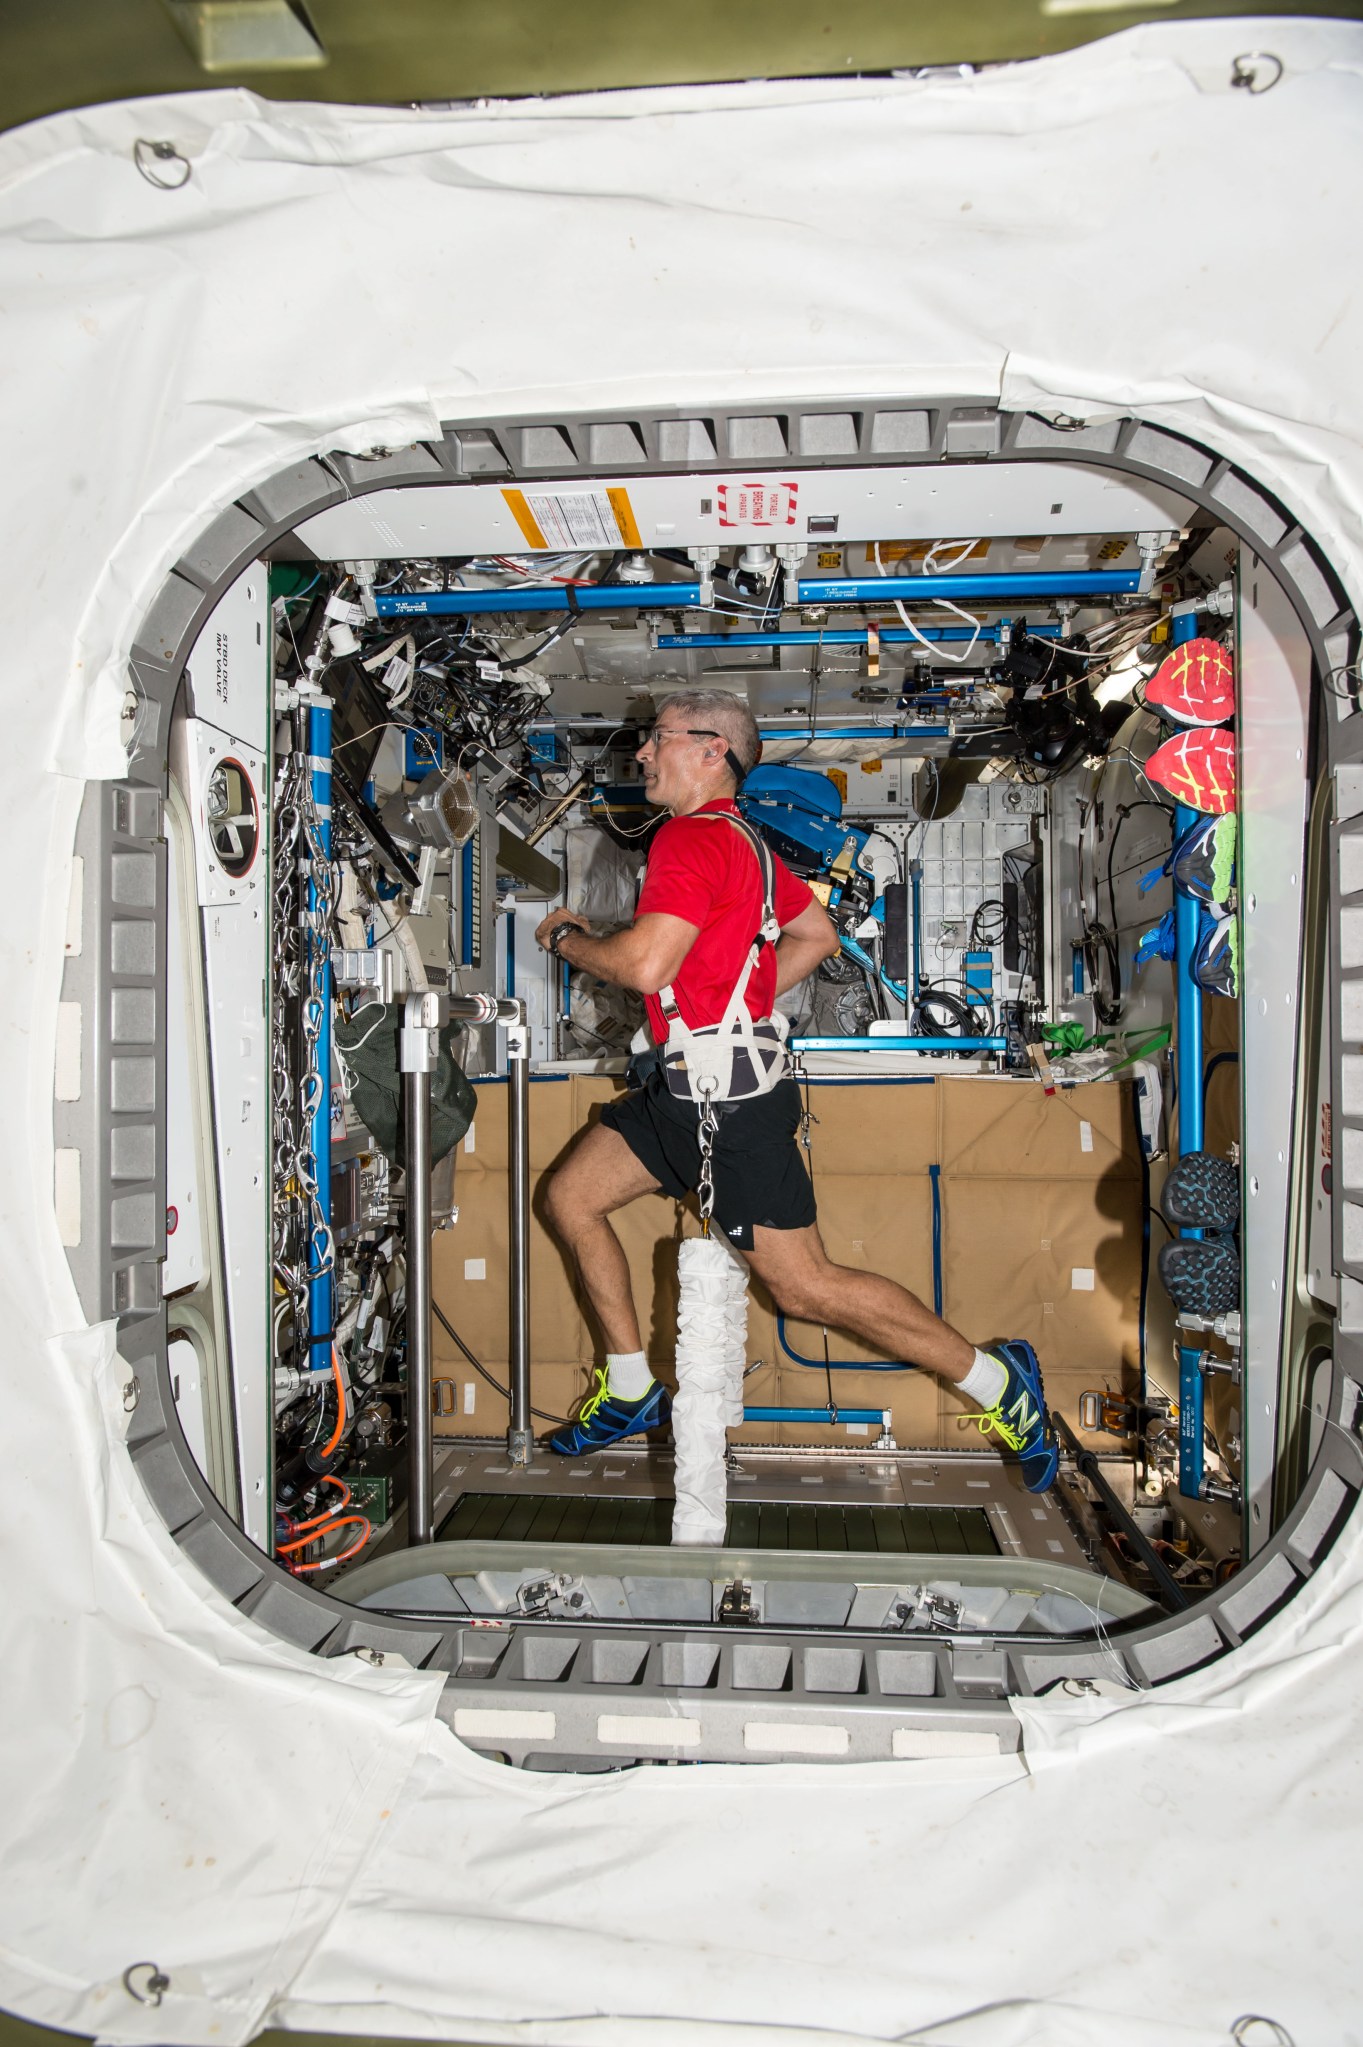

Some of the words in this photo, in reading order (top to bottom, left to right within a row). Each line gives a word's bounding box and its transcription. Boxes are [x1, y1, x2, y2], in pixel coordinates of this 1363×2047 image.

[738, 493, 747, 518] APPARATUS
[752, 491, 763, 519] BREATHING
[769, 493, 778, 516] PORTABLE
